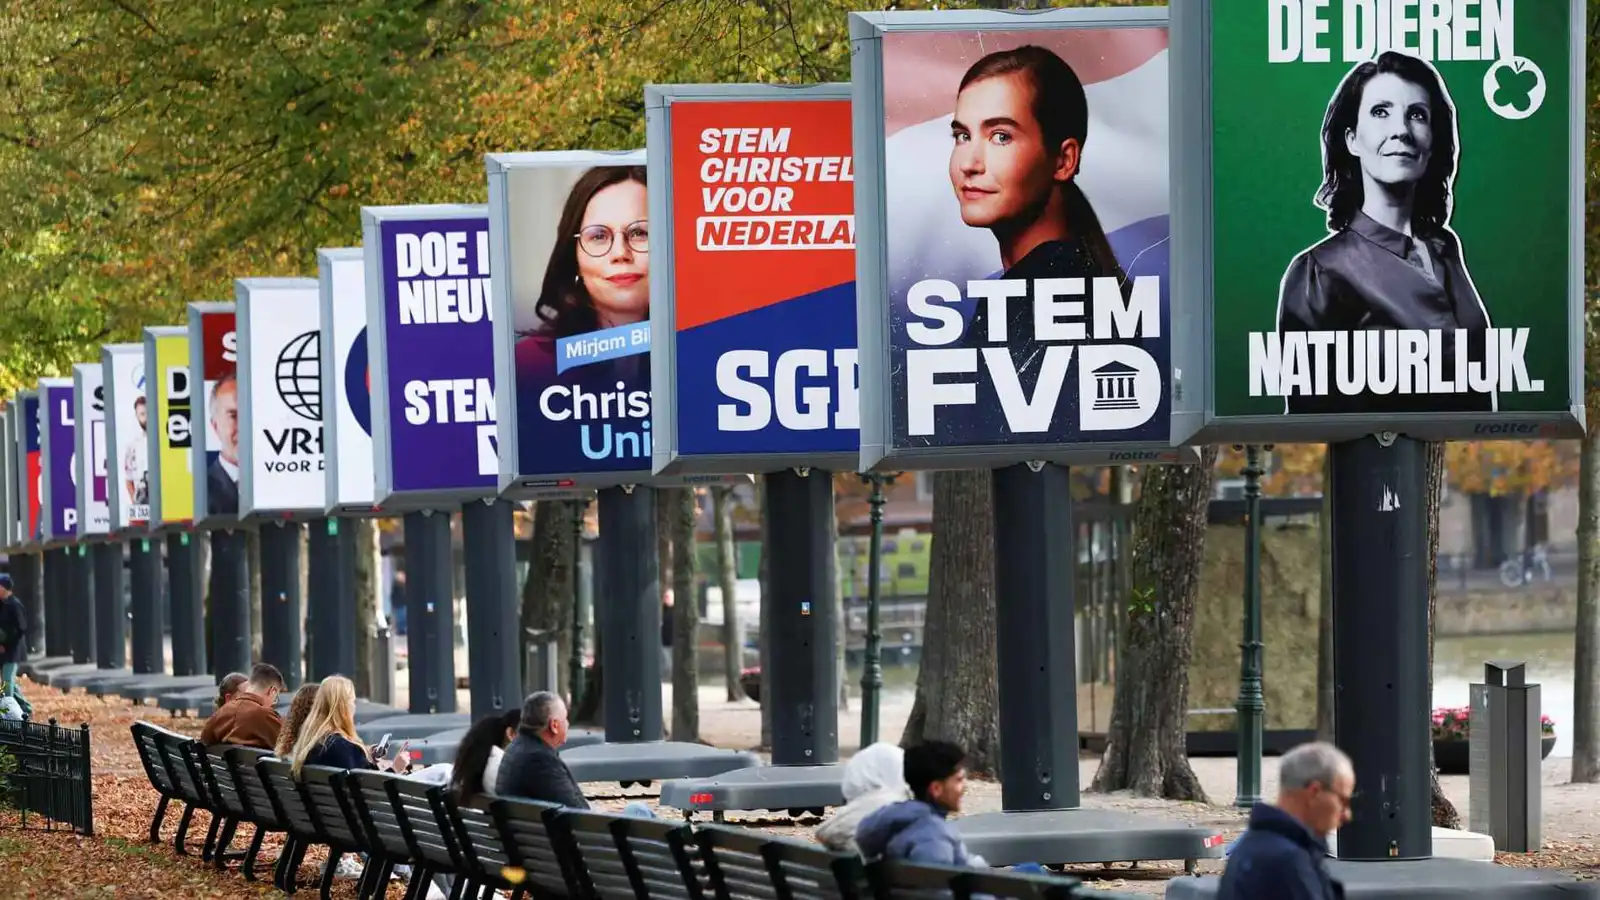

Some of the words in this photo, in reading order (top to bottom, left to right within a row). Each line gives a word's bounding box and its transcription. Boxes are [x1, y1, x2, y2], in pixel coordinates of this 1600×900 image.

[1268, 0, 1331, 63] DE
[1343, 0, 1514, 63] DIEREN
[699, 128, 791, 154] STEM
[702, 187, 794, 212] VOOR
[701, 220, 856, 245] NEDERLA
[396, 231, 468, 277] DOE
[906, 276, 1160, 345] STEM
[566, 336, 626, 359] Mirjam
[1249, 327, 1545, 397] NATUURLIJK.
[540, 381, 653, 421] Chris
[906, 344, 1162, 436] FVD
[581, 420, 655, 460] Uni
[265, 460, 310, 473] VOOR
